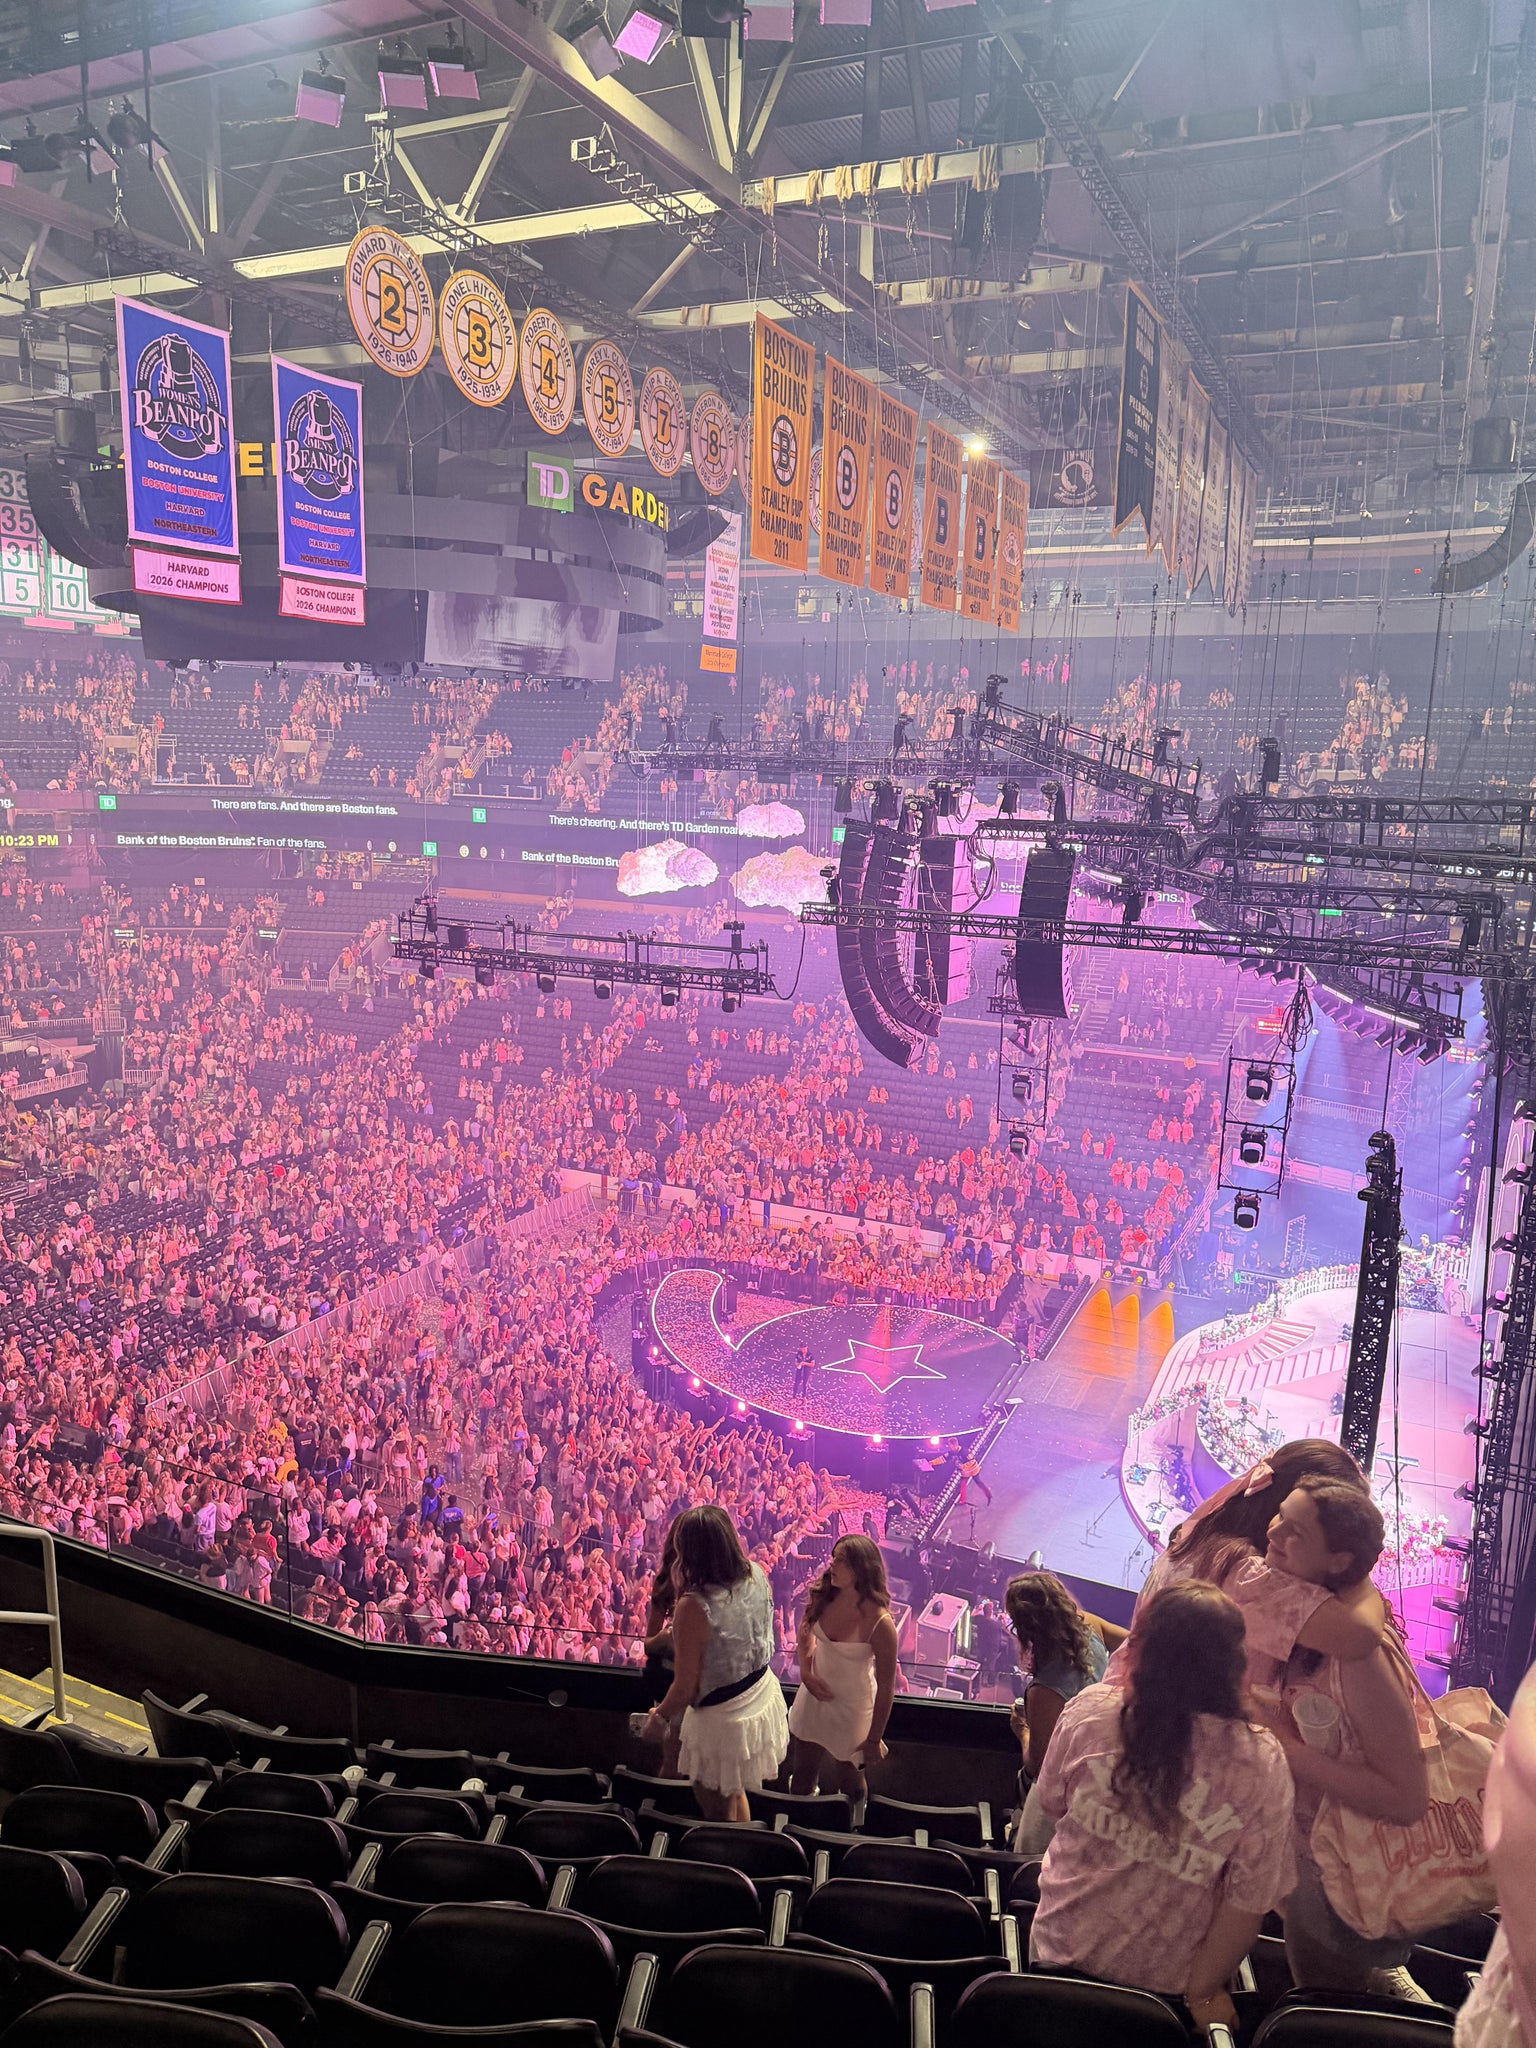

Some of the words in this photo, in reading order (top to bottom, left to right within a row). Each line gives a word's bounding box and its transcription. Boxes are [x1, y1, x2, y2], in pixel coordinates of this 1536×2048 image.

[352, 237, 387, 286] EDWARD
[406, 257, 431, 317] SHORE
[383, 285, 401, 325] 2
[445, 279, 471, 320] LIONEL
[474, 280, 513, 346] HITCHMAN
[367, 332, 418, 368] 1926-1940
[471, 323, 487, 358] 3
[524, 317, 550, 348] ROBERT
[561, 338, 572, 368] ORR
[763, 325, 809, 381] BOSTON
[457, 366, 501, 398] 1925-1934
[543, 358, 555, 389] 4
[585, 349, 603, 395] AUBREY
[612, 351, 632, 408] CLAPPER
[158, 388, 201, 409] WOMEN'S
[605, 385, 615, 415] 5
[763, 362, 807, 416] BRUINS
[832, 367, 869, 414] BOSTON
[532, 398, 565, 426] 1966-1976
[643, 377, 655, 414] PHILIP
[664, 376, 685, 431] ESPOSITO
[694, 397, 716, 433] CAMERON
[133, 389, 227, 449] BEANPOT
[660, 408, 668, 436] 7
[831, 399, 867, 446] BRUINS
[882, 398, 912, 440] BOSTON
[595, 425, 625, 450] 1927-1947
[709, 429, 718, 457] 8
[881, 428, 911, 470] BRUINS
[147, 460, 182, 476] BOSTON
[183, 469, 219, 483] COLLEGE
[284, 439, 358, 486] BEANPOT
[1, 471, 27, 499] 33
[141, 477, 177, 494] BOSTON
[178, 485, 225, 502] UNIVERSITY
[531, 462, 570, 500] TD
[165, 501, 205, 516] HARVARD
[295, 501, 322, 515] BOSTON
[323, 509, 351, 520] COLLEGE
[582, 473, 670, 533] GARDEN
[761, 486, 790, 515] STANLEY
[791, 498, 803, 518] CUP
[1, 506, 35, 535] 35
[153, 518, 218, 537] NORTHEASTERN
[290, 516, 318, 532] BOSTON
[319, 523, 355, 537] UNIVERSITY
[760, 510, 803, 541] CHAMPIONS
[827, 510, 851, 534] STANLEY
[7, 541, 34, 569] 31
[308, 538, 340, 551] HARVARD
[774, 538, 789, 560] 2011
[826, 532, 861, 560] CHAMPIONS
[167, 562, 210, 577] HARVARD
[300, 553, 350, 568] NORTHEASTERN
[836, 558, 849, 577] 1972
[15, 578, 29, 602] 5
[55, 582, 80, 608] 10
[150, 574, 174, 587] 2026
[176, 579, 229, 593] CHAMPIONS
[326, 591, 355, 602] COLLEGE
[296, 600, 315, 611] 2026
[316, 603, 357, 616] CHAMPIONS
[211, 799, 239, 809] There
[240, 801, 256, 810] are
[257, 800, 279, 811] fans.
[280, 801, 299, 811] And
[300, 802, 325, 812] there
[326, 804, 341, 813] are
[342, 803, 374, 814] Boston
[375, 805, 399, 816] fans.
[549, 814, 579, 827] There's
[579, 816, 618, 831] cheering.
[619, 819, 638, 830] And
[670, 821, 684, 832] TD
[685, 822, 719, 834] Garden
[0, 834, 35, 847] 10:23
[37, 834, 59, 846] PM
[117, 835, 145, 845] Bank
[146, 835, 158, 845] of
[159, 835, 178, 845] the
[178, 835, 217, 846] Boston
[256, 836, 276, 846] Fan
[276, 837, 287, 847] of
[287, 838, 303, 848] the
[303, 838, 327, 849] fans.
[521, 850, 545, 862] Bank
[545, 852, 556, 863] of
[556, 853, 572, 864] the
[572, 854, 605, 866] Boston
[1157, 892, 1181, 903] ans.
